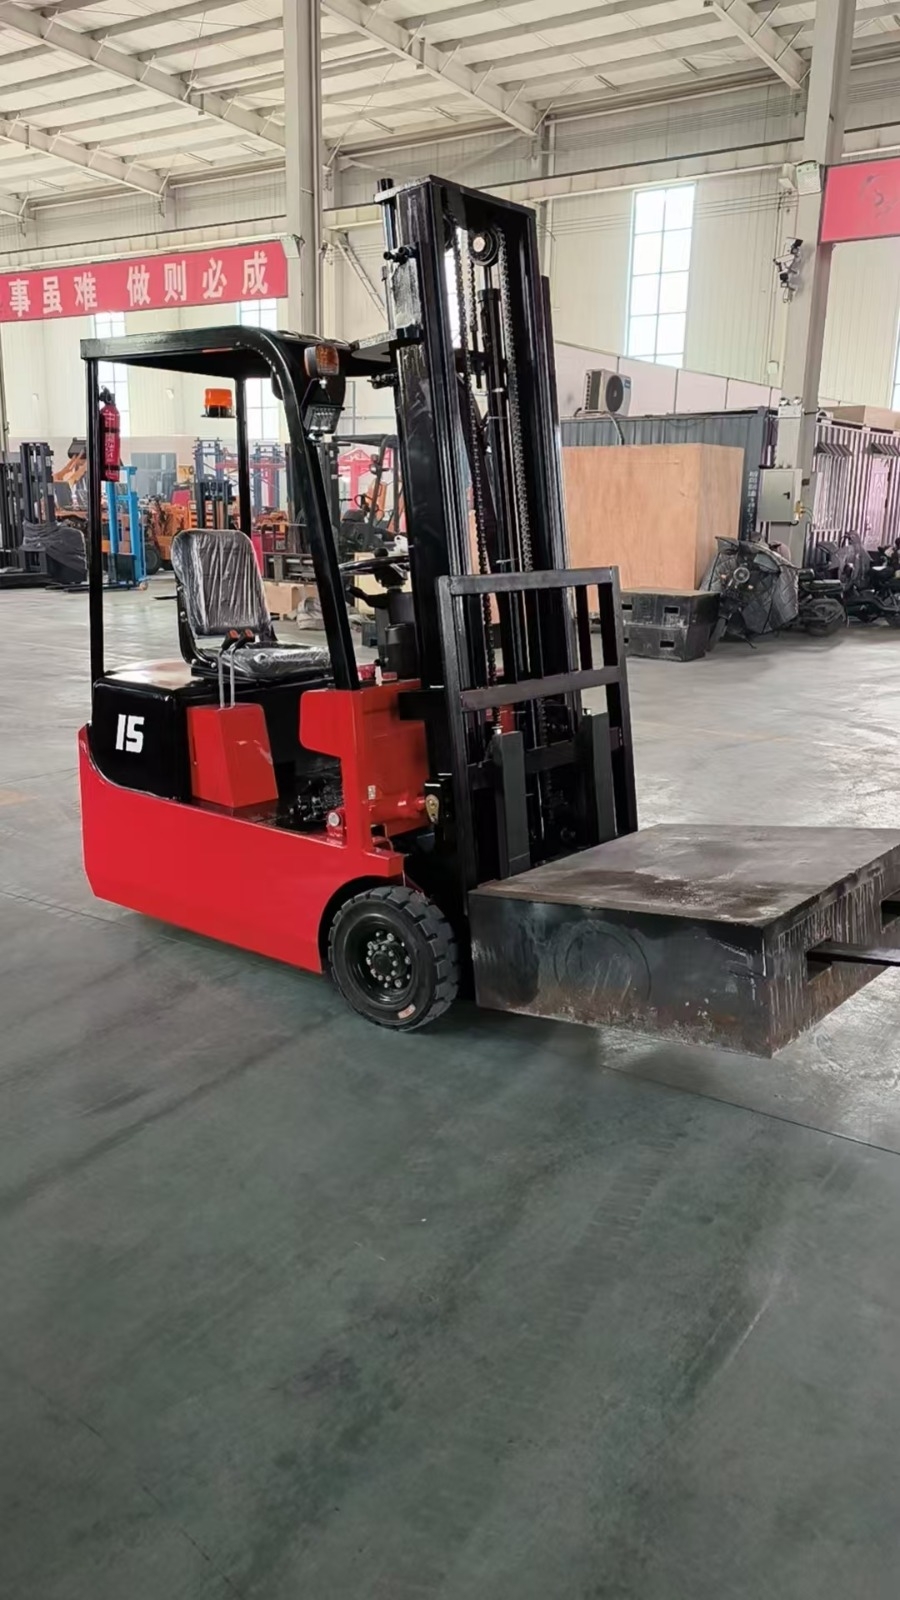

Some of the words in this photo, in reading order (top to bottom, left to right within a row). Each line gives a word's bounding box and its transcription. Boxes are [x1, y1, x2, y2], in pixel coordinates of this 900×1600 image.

[8, 271, 98, 317] 事虽难
[127, 251, 268, 307] 做则必成
[115, 713, 145, 753] 15
